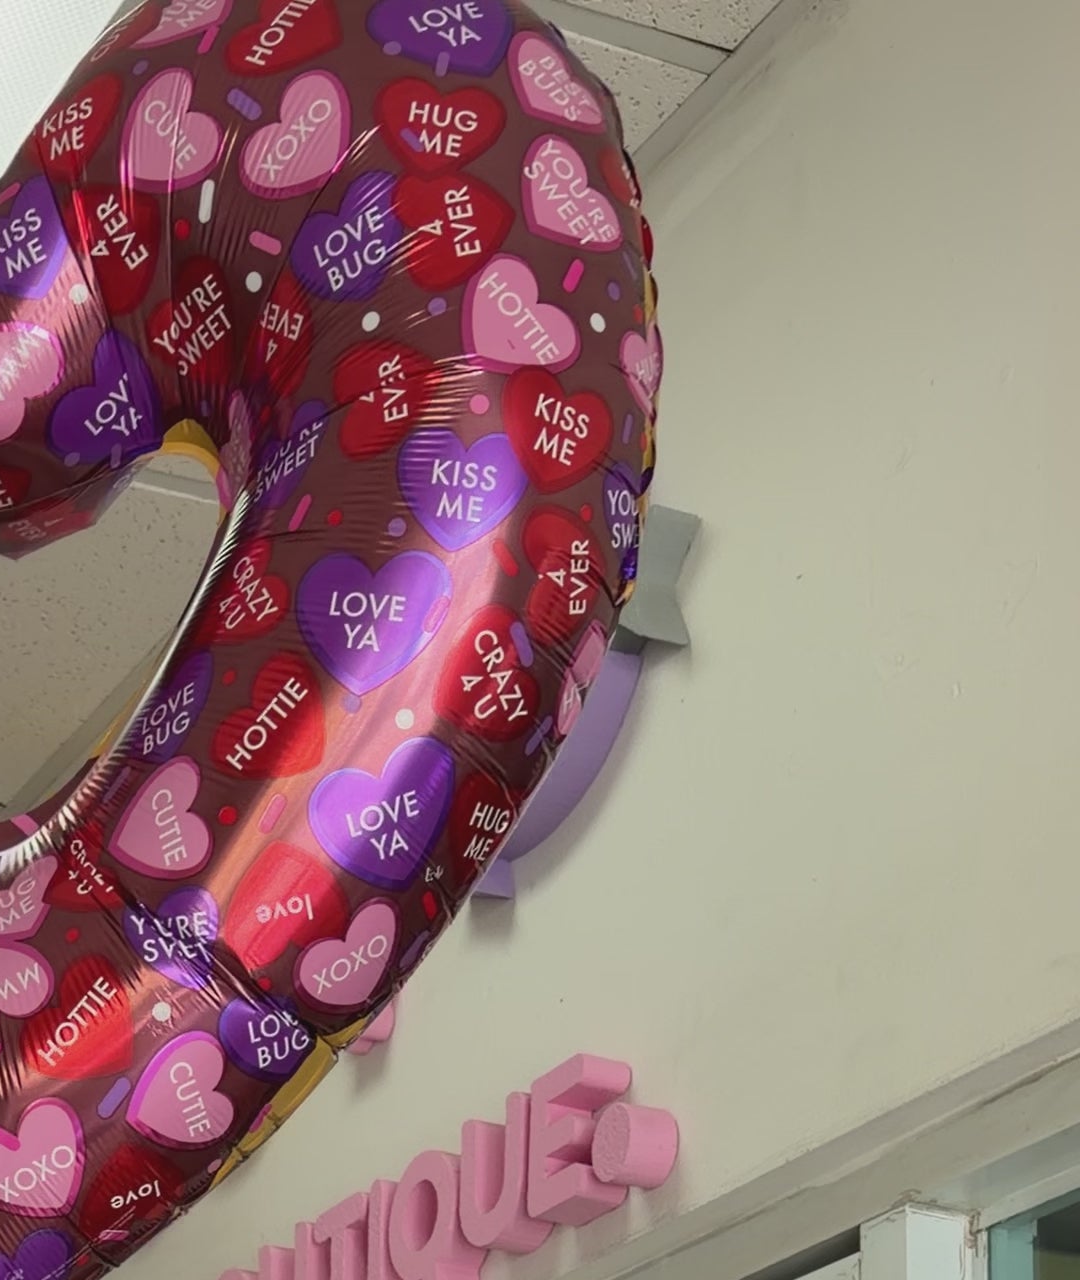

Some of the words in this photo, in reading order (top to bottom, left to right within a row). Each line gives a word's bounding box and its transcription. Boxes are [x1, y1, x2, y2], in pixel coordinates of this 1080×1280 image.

[408, 2, 483, 33] LOVE
[438, 25, 482, 47] YA
[518, 59, 579, 122] BUDS
[540, 55, 591, 107] BEST
[42, 98, 93, 139] KISS
[408, 101, 478, 133] HUG
[50, 125, 85, 160] ME
[261, 99, 332, 182] XOXO
[419, 131, 463, 157] ME
[523, 161, 600, 246] SWEET
[538, 139, 617, 242] YOU'RE
[96, 194, 149, 270] EVER
[313, 205, 385, 268] LOVE
[445, 186, 482, 257] EVER
[4, 237, 48, 279] ME
[92, 239, 109, 257] 4
[327, 238, 388, 292] BUG
[154, 274, 223, 355] YOU'RE
[480, 272, 559, 365] HOTTIE
[177, 305, 232, 376] SWEET
[379, 355, 409, 423] EVER
[534, 393, 590, 439] KISS
[534, 428, 576, 466] ME
[432, 460, 497, 491] KISS
[435, 493, 485, 524] ME
[232, 556, 278, 622] CRAZY
[547, 569, 566, 586] 4
[569, 540, 589, 615] EVER
[219, 595, 233, 612] 4
[225, 610, 245, 629] U
[329, 592, 406, 622] LOVE
[343, 623, 380, 653] YA
[461, 675, 483, 691] 4
[474, 697, 497, 720] U
[474, 630, 528, 722] CRAZY
[141, 682, 194, 737] LOVE
[226, 677, 308, 771] HOTTIE
[142, 712, 190, 756] BUG
[150, 789, 187, 866] CUTIE
[346, 790, 420, 838] LOVE
[471, 801, 510, 834] HUG
[370, 831, 409, 860] YA
[464, 836, 493, 862] ME
[0, 901, 36, 932] ME
[255, 895, 314, 921] love
[312, 934, 387, 994] XOXO
[37, 976, 118, 1067] HOTTIE
[257, 1030, 311, 1069] BUG
[170, 1062, 211, 1137] CUTIE
[110, 1180, 161, 1209] love
